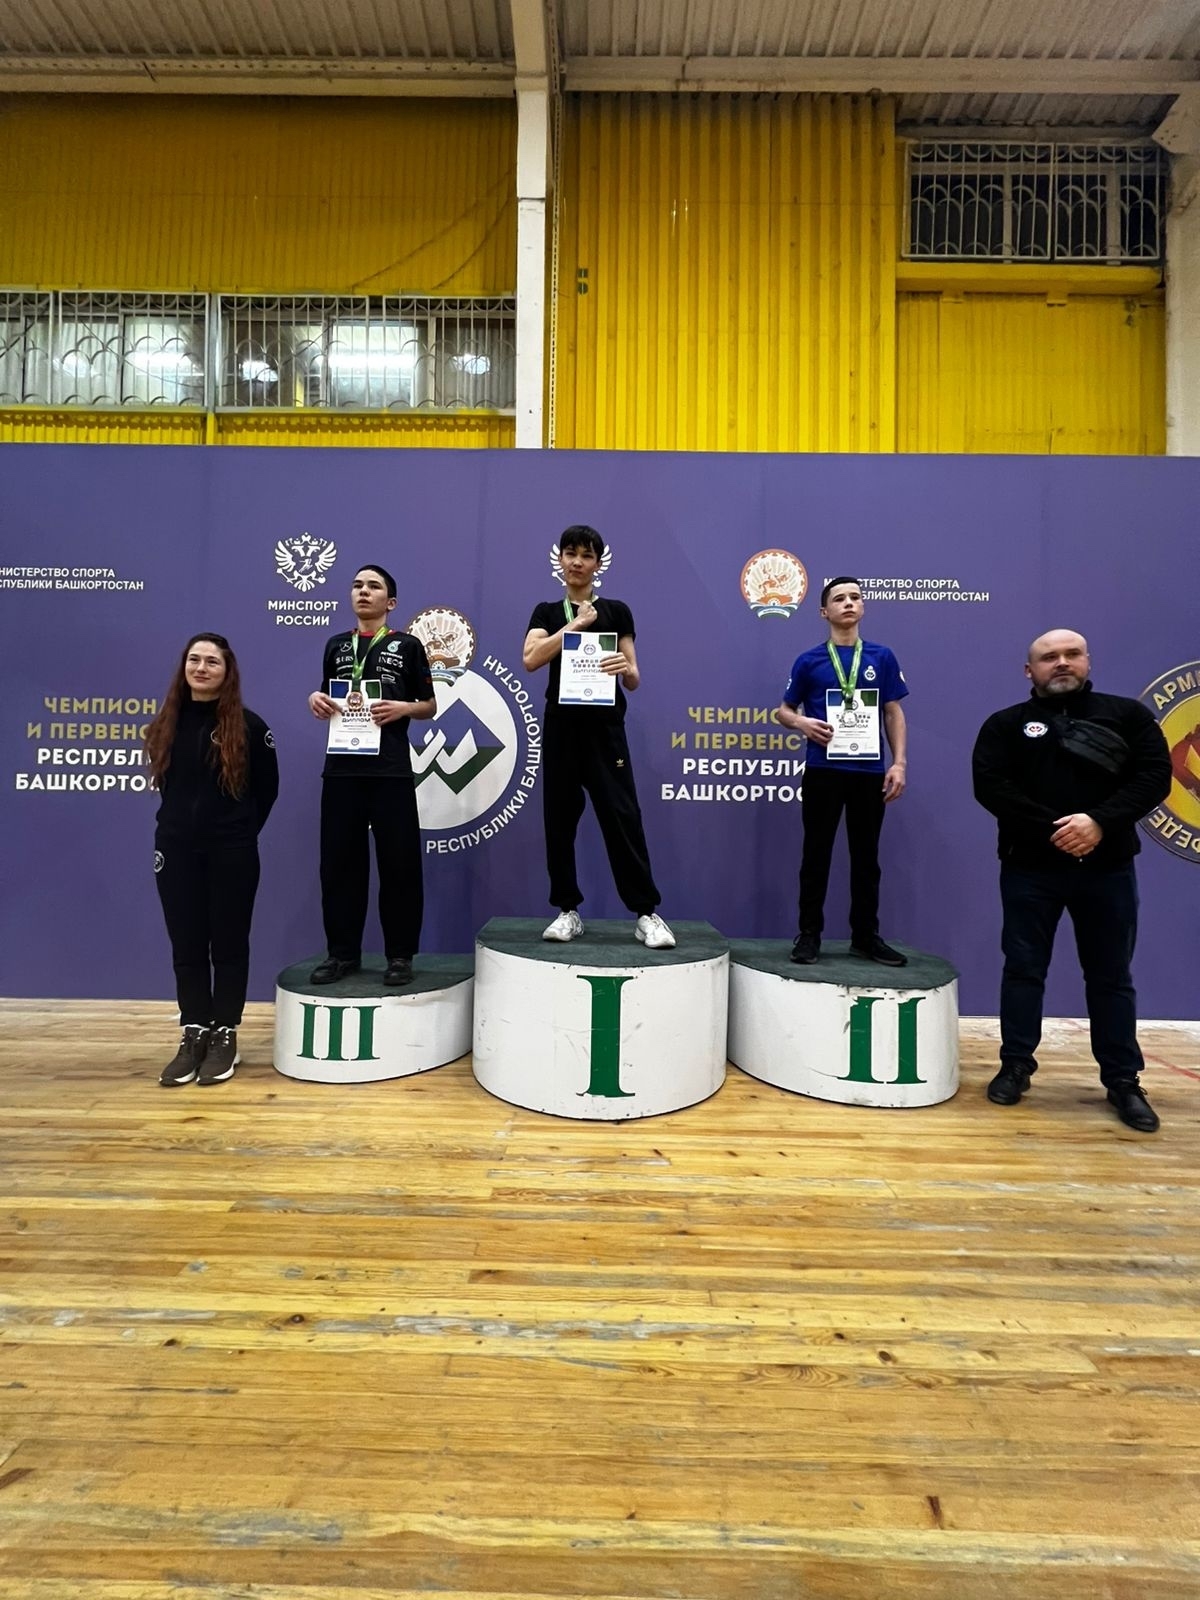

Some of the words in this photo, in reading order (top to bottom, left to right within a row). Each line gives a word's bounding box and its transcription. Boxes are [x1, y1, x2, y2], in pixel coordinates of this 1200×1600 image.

[72, 567, 116, 578] СПОРТА
[55, 579, 144, 590] БАШКОРТОСТАН
[915, 578, 960, 589] СПОРТА
[899, 591, 990, 602] БАШКОРТОСТАН
[267, 600, 339, 612] МИНСПОРТ
[276, 615, 330, 626] РОССИИ
[44, 696, 157, 715] ЧЕМПИОН
[687, 706, 783, 725] ЧЕМПИО
[27, 722, 42, 739] И
[671, 732, 687, 749] И
[694, 733, 807, 750] ПЕРВЕНС
[37, 748, 152, 766] РЕСПУБЛ
[426, 789, 529, 854] РЕСПУБЛИКИ
[482, 655, 542, 790] БАШКОРТОСТАН
[683, 758, 806, 776] РЕСПУБЛИ
